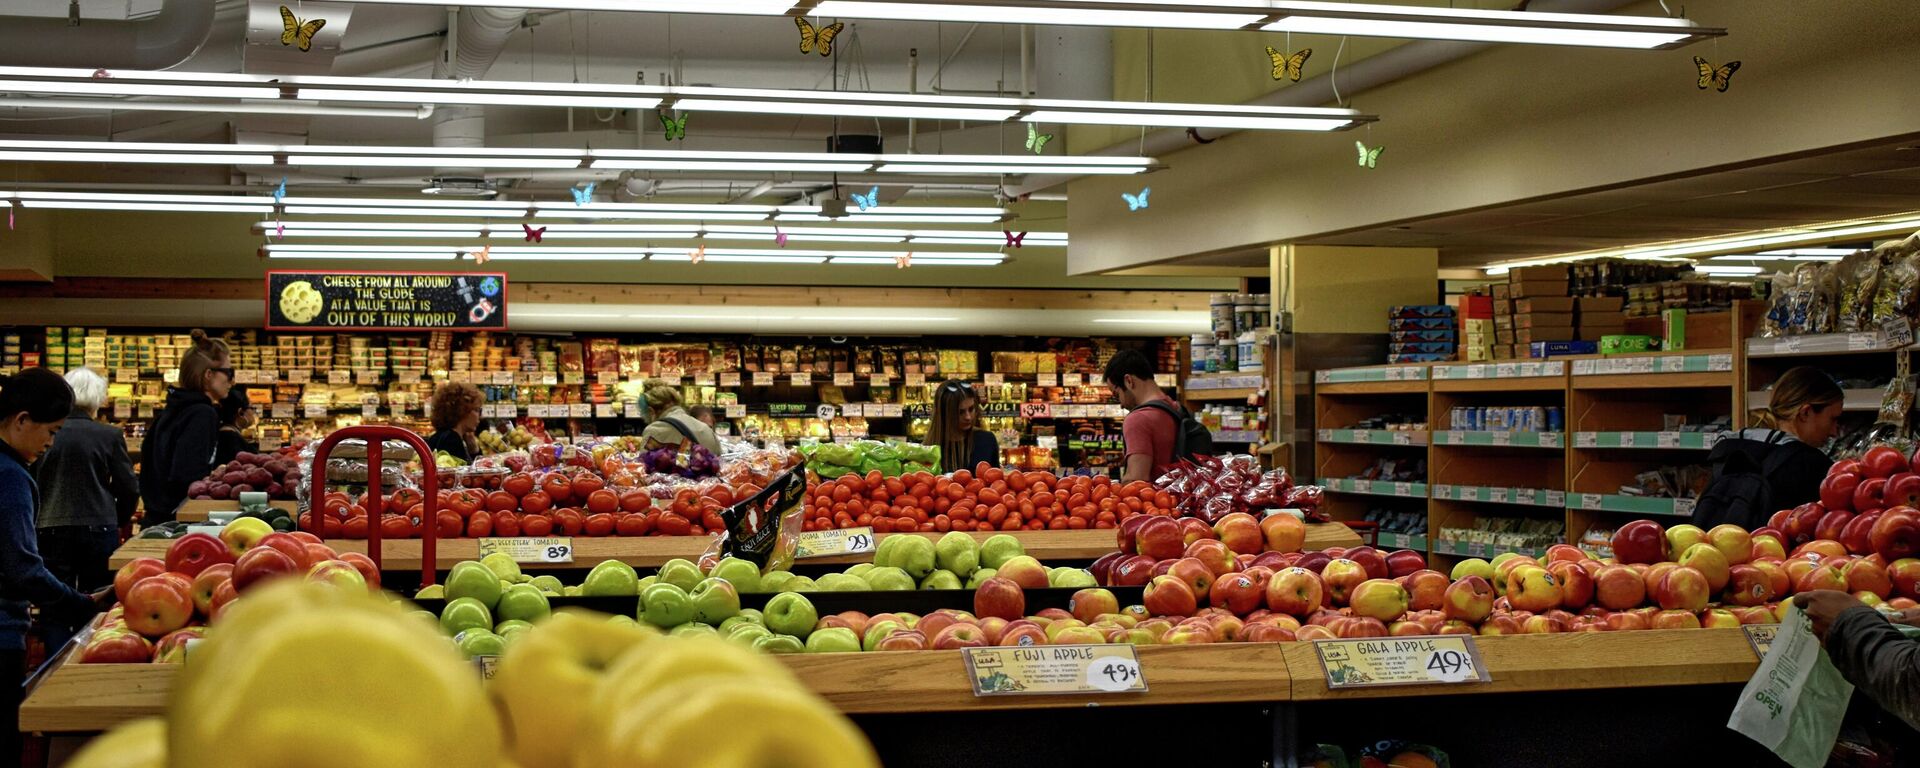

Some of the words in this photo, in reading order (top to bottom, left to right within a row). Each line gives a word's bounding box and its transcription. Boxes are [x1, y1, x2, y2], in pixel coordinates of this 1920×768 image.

[323, 276, 362, 287] CHEESE
[364, 277, 392, 287] FROM
[394, 277, 409, 287] ALL
[412, 276, 451, 288] AROUND
[355, 288, 375, 299] THE
[379, 288, 414, 299] GLOBE
[354, 299, 387, 310] VALUE
[391, 300, 416, 310] THAT
[420, 300, 431, 311] IS
[327, 312, 355, 325] OUT
[360, 312, 377, 325] OF
[382, 312, 410, 326] THIS
[413, 312, 456, 326] WORLD
[823, 530, 847, 538] TOMATO
[1357, 642, 1389, 654] GALA
[1394, 640, 1436, 653] APPLE
[1014, 649, 1045, 661] FUJI
[1053, 647, 1093, 660] APPLE
[1755, 691, 1782, 714] OPEN
